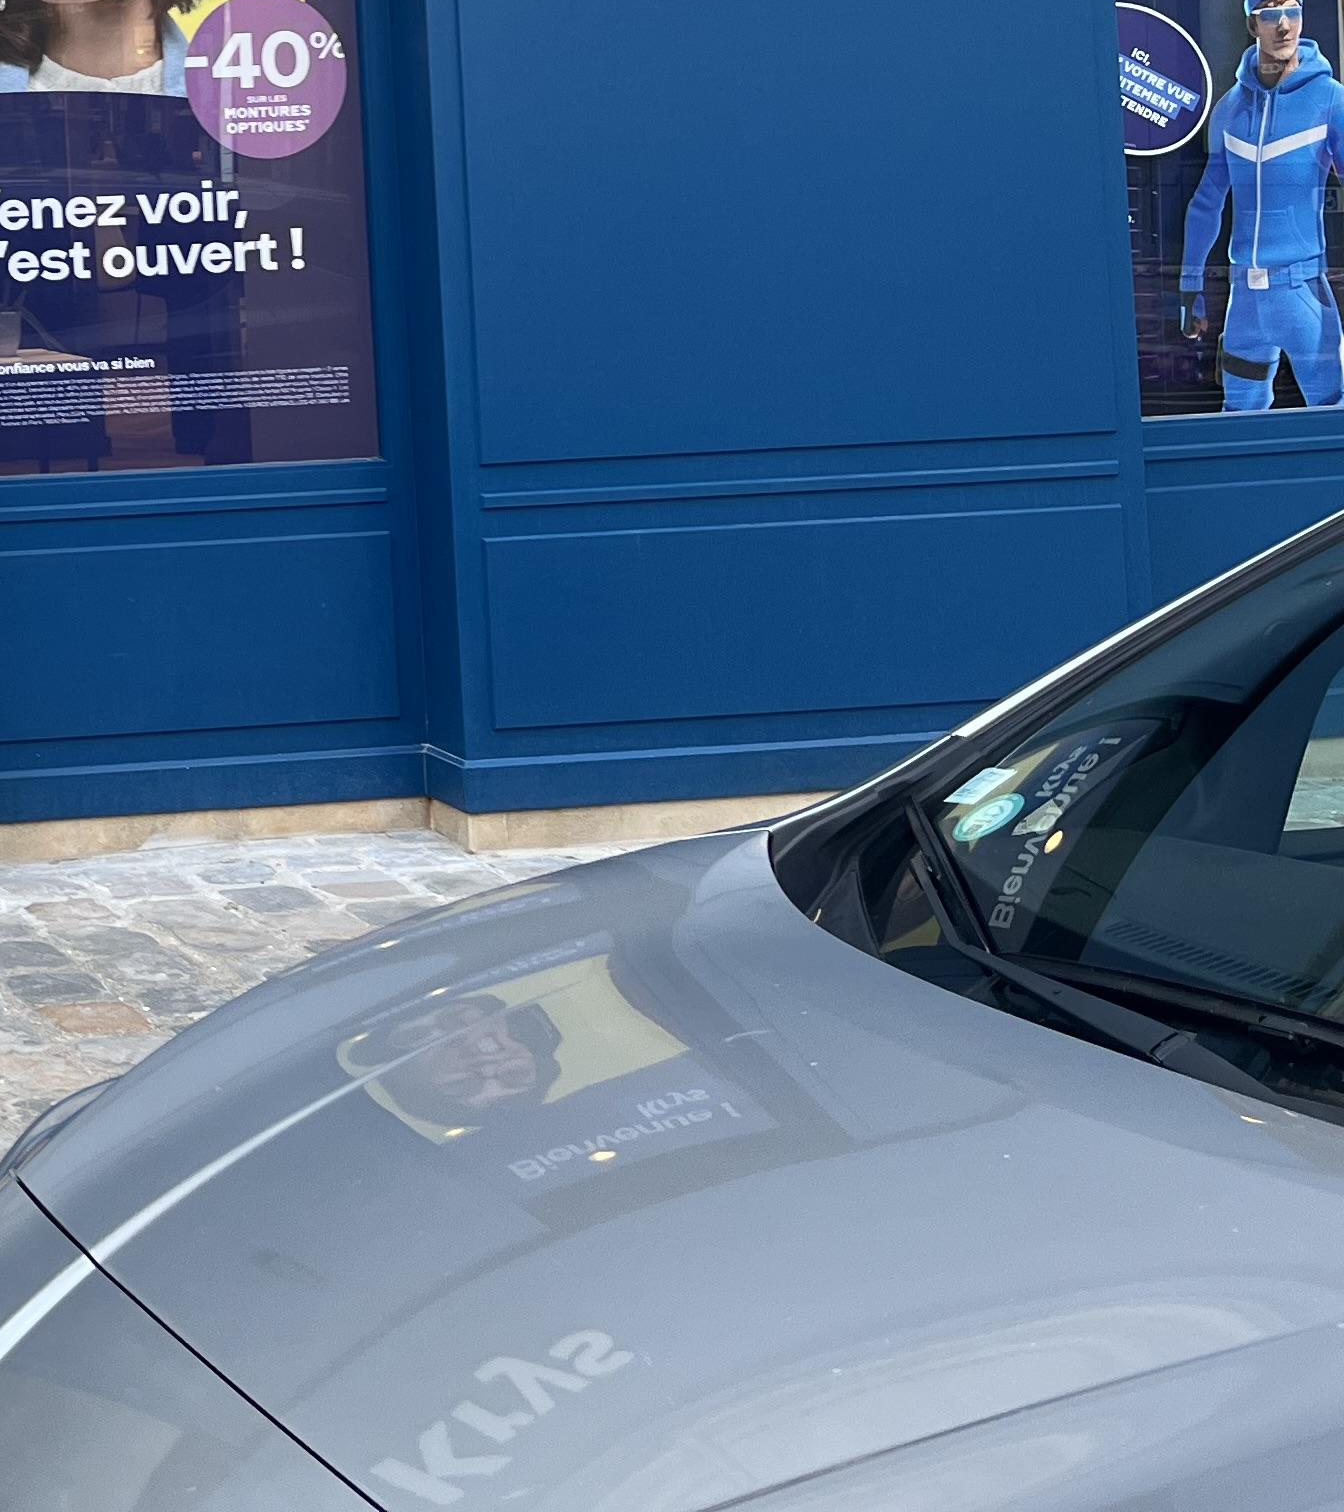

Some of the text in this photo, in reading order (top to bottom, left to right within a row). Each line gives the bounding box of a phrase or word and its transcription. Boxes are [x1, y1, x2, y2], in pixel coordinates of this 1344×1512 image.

[1130, 47, 1151, 67] ICI,
[1124, 60, 1196, 105] VOTRE VUE
[246, 94, 288, 104] SUR LES
[224, 105, 312, 119] MONTURES
[136, 180, 248, 230] voir,
[102, 233, 278, 278] ouvert
[289, 227, 306, 270] !
[57, 361, 90, 372] vous
[91, 360, 109, 371] va
[111, 357, 123, 370] si
[124, 357, 156, 369] bien
